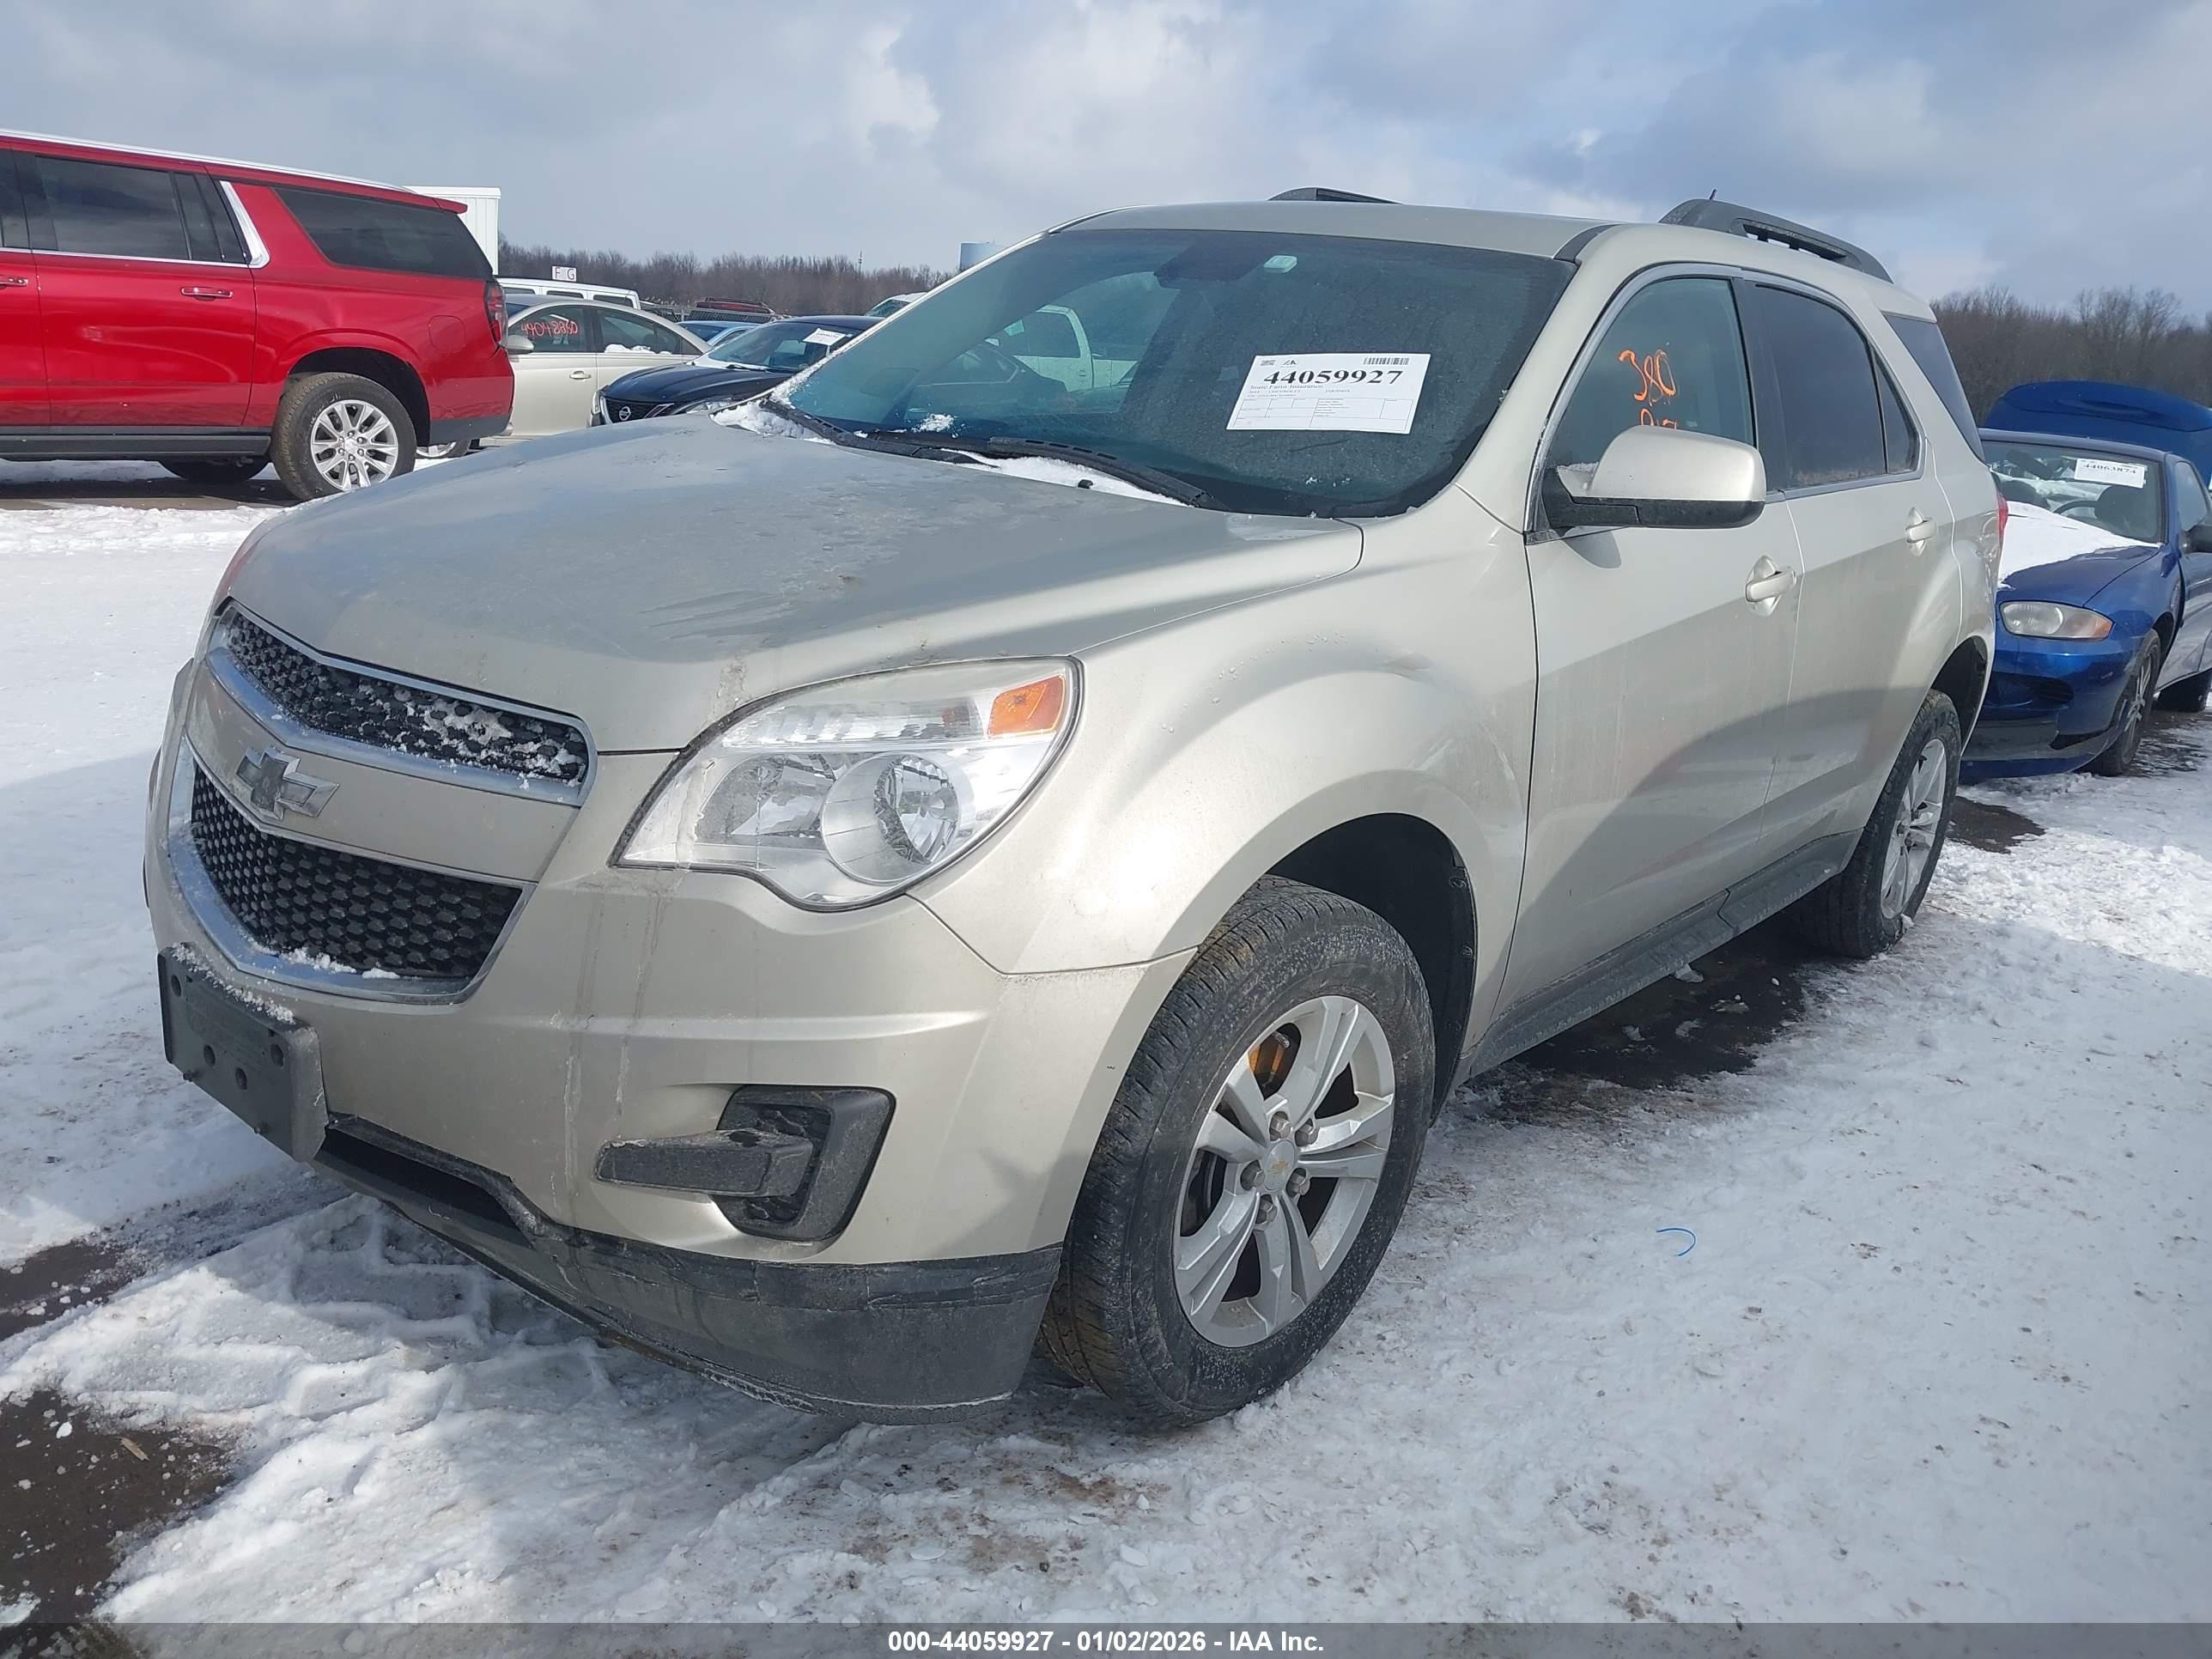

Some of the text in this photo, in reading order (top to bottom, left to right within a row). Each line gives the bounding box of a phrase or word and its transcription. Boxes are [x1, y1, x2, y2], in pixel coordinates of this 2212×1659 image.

[555, 267, 575, 281] F G
[1263, 369, 1404, 385] 44059927
[1618, 348, 1676, 406] 380
